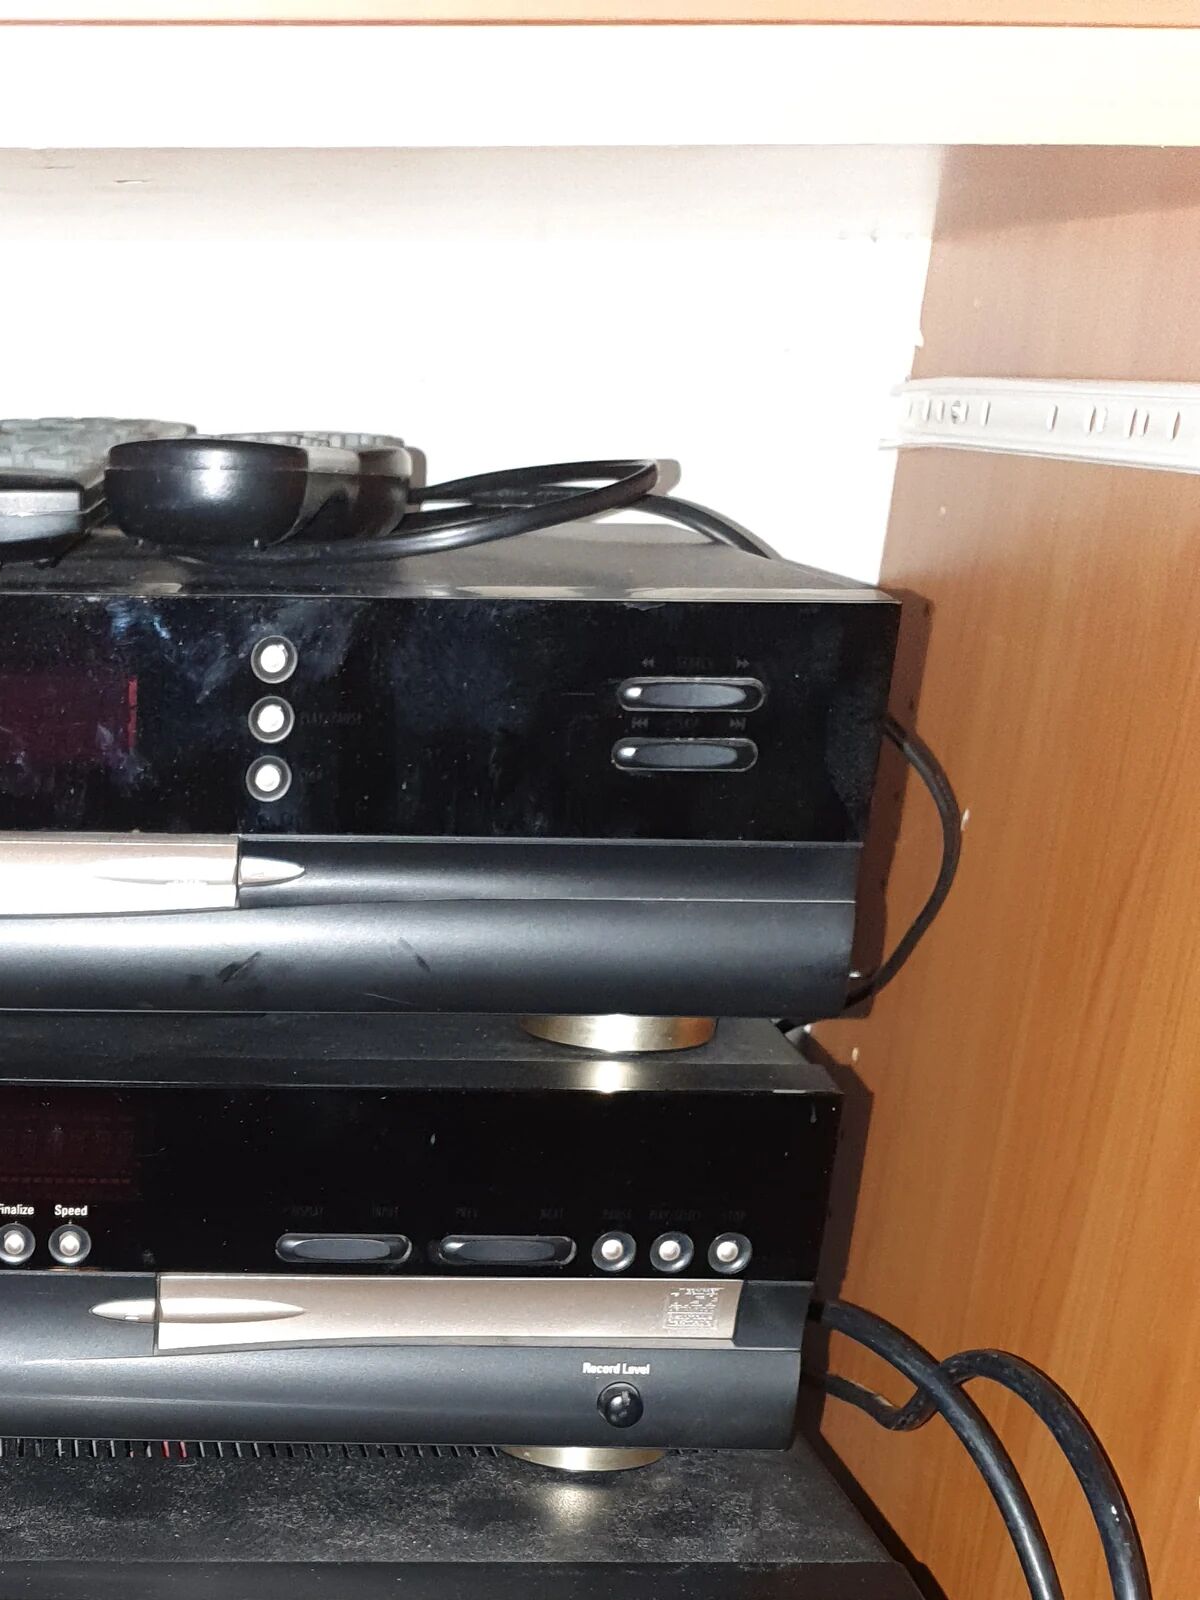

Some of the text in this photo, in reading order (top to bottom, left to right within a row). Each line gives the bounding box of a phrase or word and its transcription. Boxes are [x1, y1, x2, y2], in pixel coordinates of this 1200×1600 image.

[54, 1204, 89, 1217] Speed
[582, 1362, 651, 1375] Record Level
